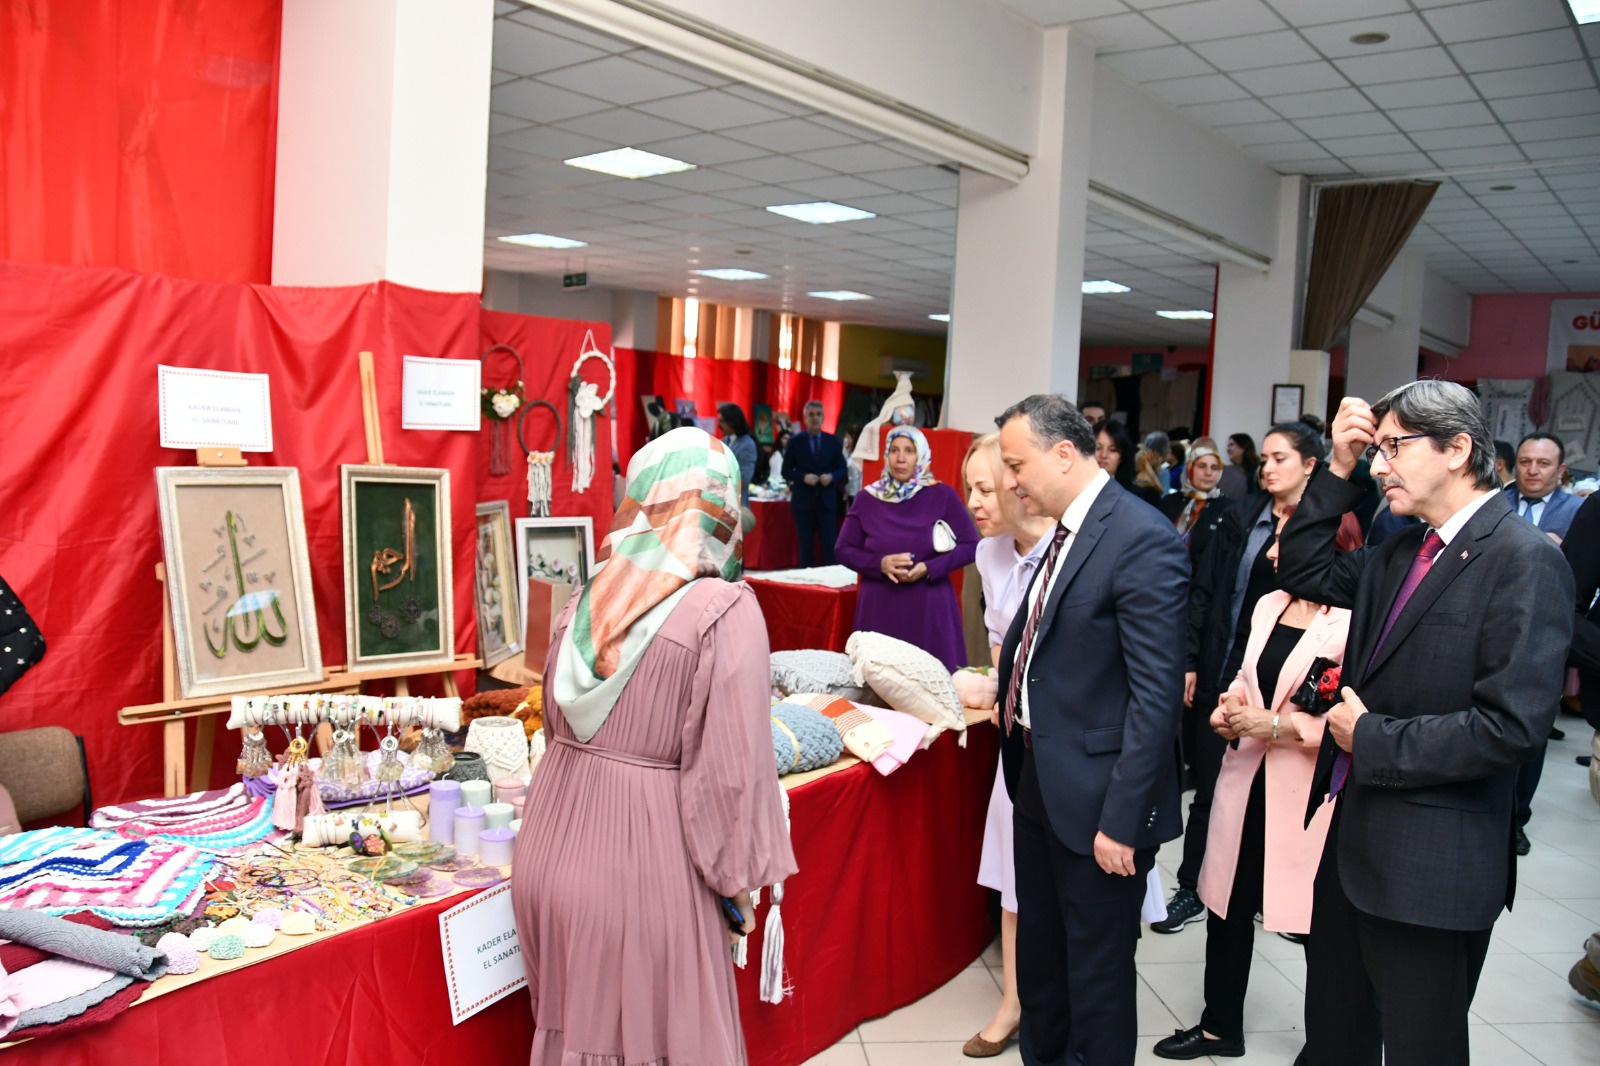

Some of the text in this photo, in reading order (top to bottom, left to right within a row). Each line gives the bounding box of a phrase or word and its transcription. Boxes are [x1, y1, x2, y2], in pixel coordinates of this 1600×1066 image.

[477, 928, 517, 954] KADER ELA
[483, 960, 492, 970] EL
